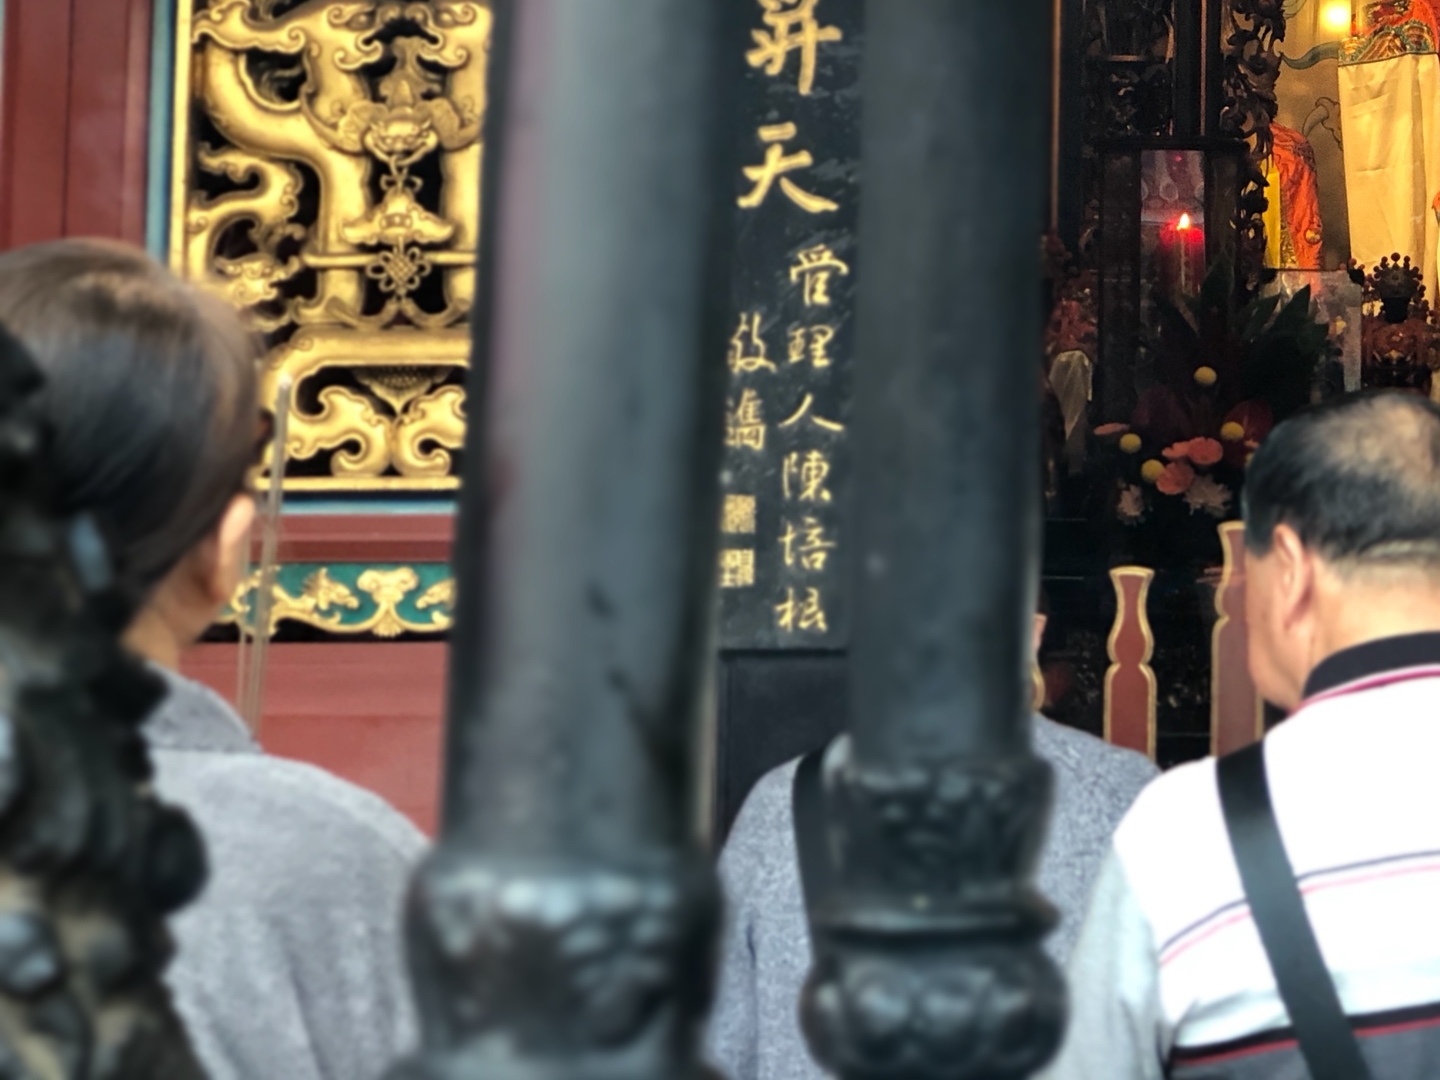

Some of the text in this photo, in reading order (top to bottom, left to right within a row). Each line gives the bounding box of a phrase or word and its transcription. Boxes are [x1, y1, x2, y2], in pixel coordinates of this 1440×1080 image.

[776, 243, 850, 631] 管理人陳培根
